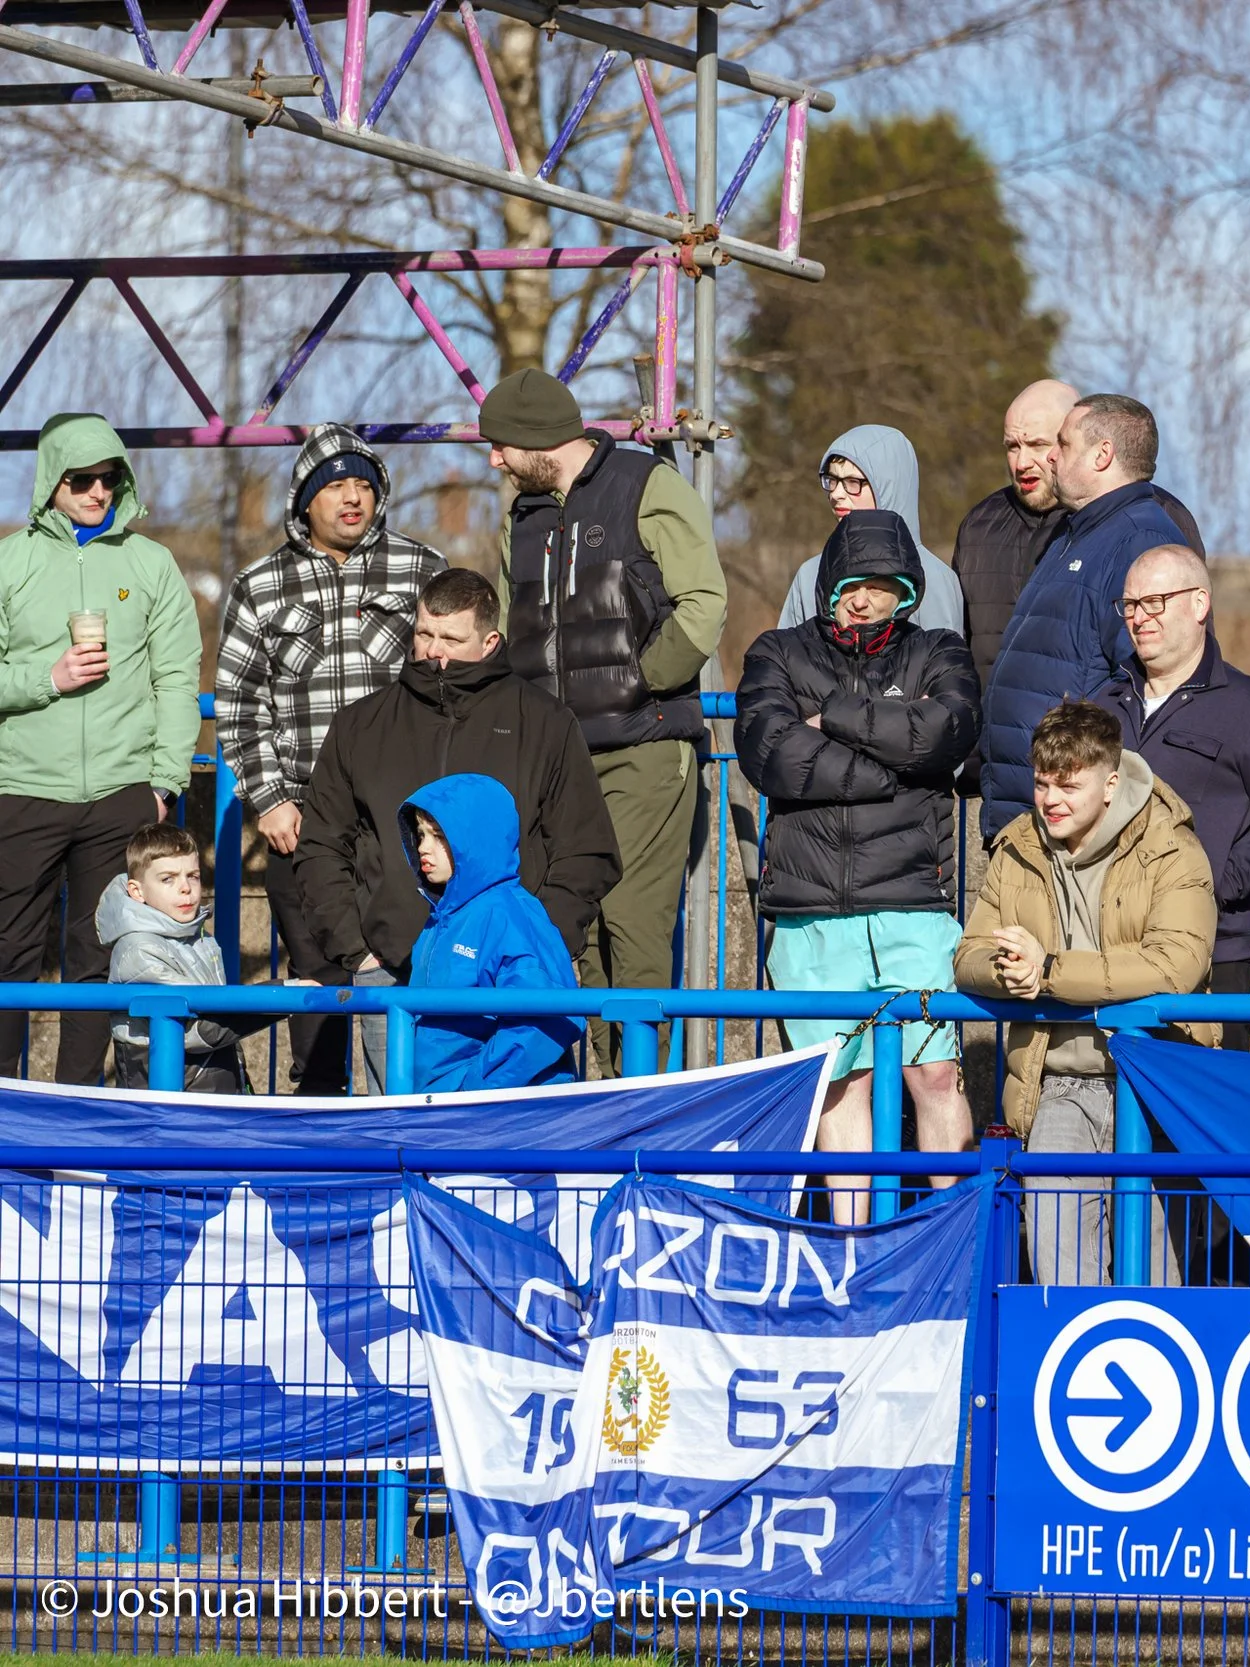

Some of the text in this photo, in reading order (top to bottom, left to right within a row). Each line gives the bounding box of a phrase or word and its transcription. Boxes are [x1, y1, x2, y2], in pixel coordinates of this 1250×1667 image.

[727, 1367, 846, 1450] 63
[1042, 1524, 1104, 1576] HPE
[1116, 1526, 1215, 1585] (m/c)
